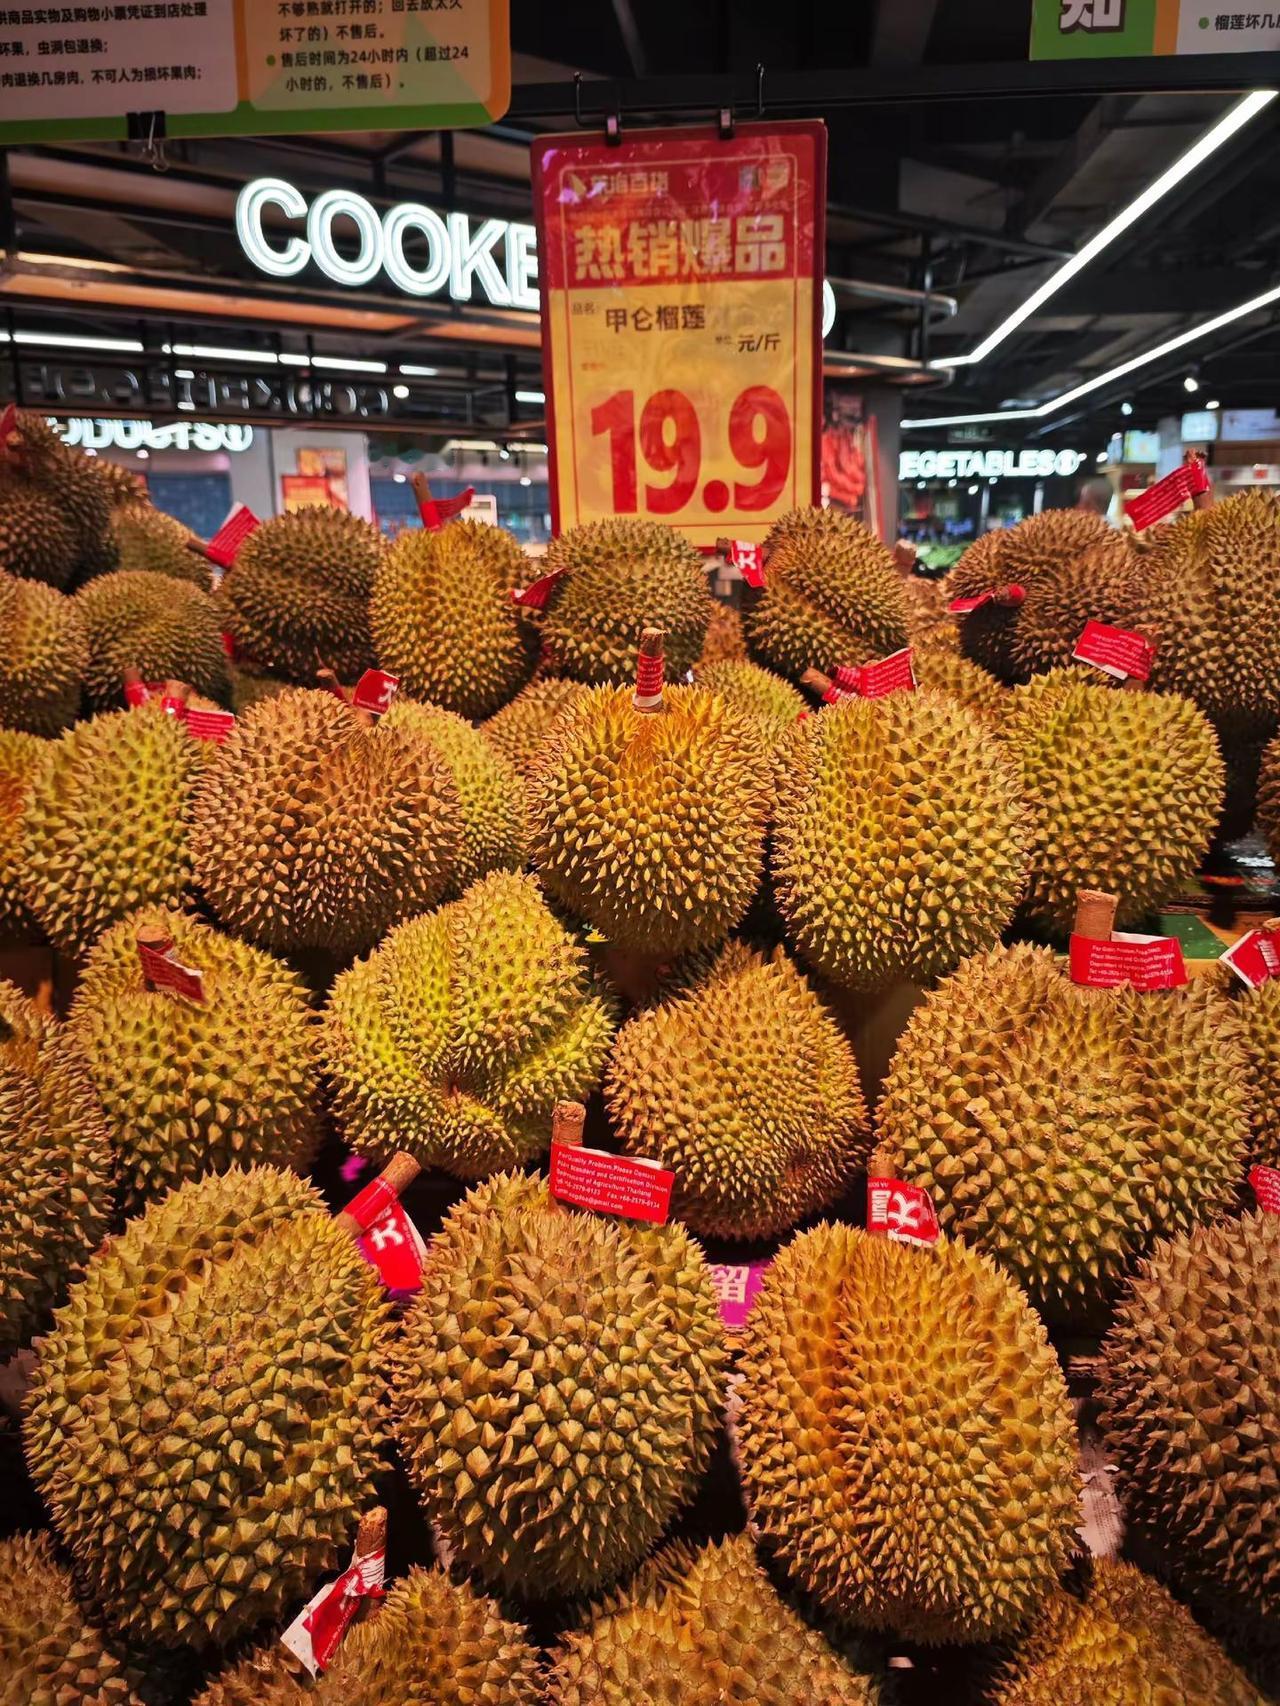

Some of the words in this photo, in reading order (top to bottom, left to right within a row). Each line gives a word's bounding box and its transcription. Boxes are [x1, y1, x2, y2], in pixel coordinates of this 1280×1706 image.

[574, 214, 785, 280] 热销爆品
[605, 304, 706, 333] 甲仑榴莲
[738, 333, 781, 352] 元/斤
[591, 385, 792, 514] 19.9
[899, 449, 1056, 479] EGETABLES
